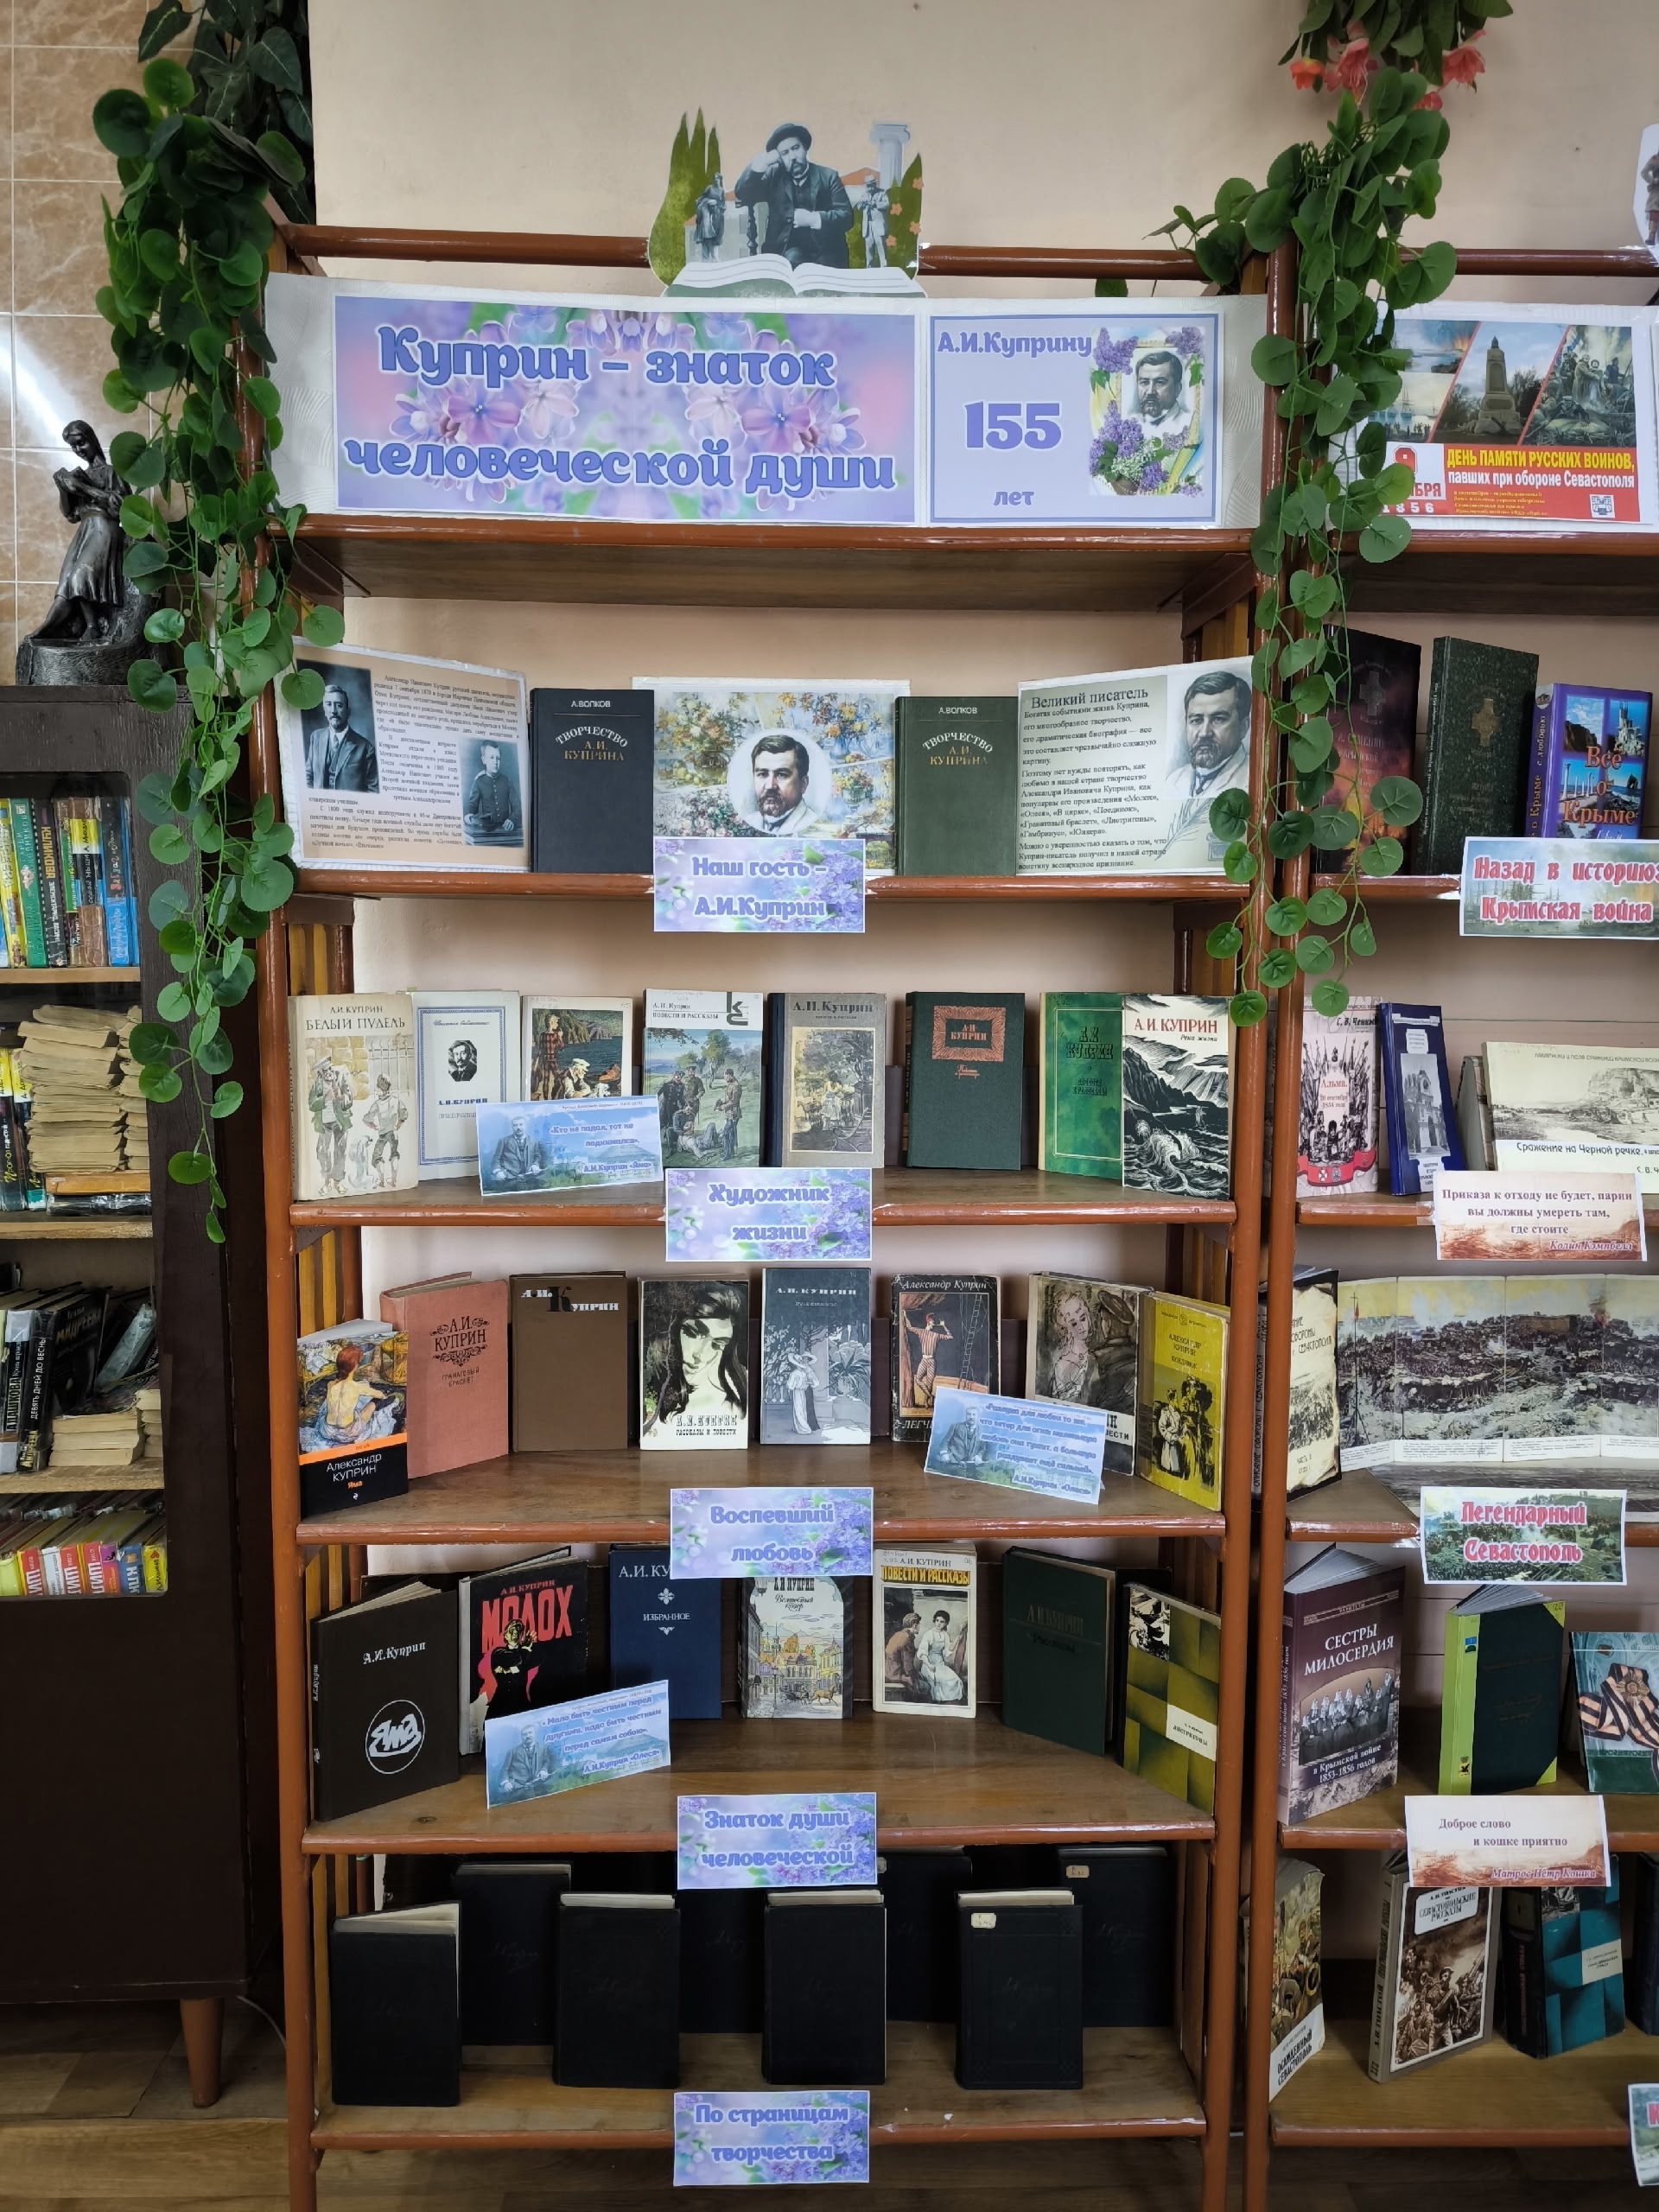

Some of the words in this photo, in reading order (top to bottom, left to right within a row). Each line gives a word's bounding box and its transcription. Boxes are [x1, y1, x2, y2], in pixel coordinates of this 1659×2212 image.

[938, 332, 1092, 358] А.И.Куприну
[378, 326, 589, 389] Куприн
[646, 349, 834, 386] знаток
[964, 400, 1062, 450] 155
[345, 438, 732, 488] человеческой
[747, 453, 895, 495] души
[1447, 449, 1477, 468] ДЕНЬ
[1480, 450, 1526, 467] ПАМЯТИ
[1529, 451, 1581, 469] РУССКИХ
[1584, 452, 1635, 472] ВОИНОВ,
[1448, 471, 1491, 486] павших
[1493, 473, 1512, 488] при
[1515, 470, 1561, 489] обороне
[1564, 471, 1635, 488] Севастополя
[993, 490, 1034, 506] лет
[1032, 692, 1086, 709] Великий
[1090, 689, 1148, 702] писатель
[555, 726, 628, 747] ТВОРЧЕСТВО
[922, 732, 993, 753] ТВОРЧЕСТВО
[564, 750, 624, 761] КУПРИНА
[1585, 746, 1624, 770] Всё
[1562, 800, 1636, 828] Крыме
[41, 826, 55, 879] КУЛИКОВА
[692, 856, 745, 877] Наш
[750, 858, 810, 879] гость
[1474, 857, 1535, 882] Назад
[1548, 861, 1559, 880] в
[695, 897, 825, 920] А.И.Куприн
[1482, 897, 1580, 923] Крымская
[1593, 900, 1653, 923] война
[357, 1017, 405, 1029] ПУДЕЛЬ
[1161, 1017, 1218, 1034] КУПРИН
[950, 1032, 987, 1041] КУПРИН
[1516, 1142, 1562, 1153] Сражение
[1579, 1145, 1612, 1155] Черной
[709, 1184, 830, 1206] Художник
[1442, 1189, 1491, 1203] Приказа
[1494, 1192, 1502, 1200] к
[1505, 1191, 1542, 1203] отходу
[1560, 1189, 1595, 1204] будет,
[1598, 1192, 1632, 1204] парни
[1468, 1209, 1484, 1217] вы
[1487, 1208, 1534, 1219] должны
[1536, 1209, 1583, 1220] умереть
[1586, 1209, 1610, 1219] там,
[733, 1225, 807, 1242] жизни
[1510, 1225, 1529, 1236] где
[1532, 1225, 1568, 1235] стоите
[903, 1278, 951, 1291] Александр
[954, 1279, 987, 1290] Куприн
[435, 1328, 486, 1352] КУПРИН
[35, 1363, 43, 1373] ДО
[32, 1375, 41, 1394] ДНЕЙ
[30, 1395, 39, 1420] ДЕВЯТЬ
[327, 1453, 382, 1473] Александр
[333, 1465, 377, 1482] КУПРИН
[347, 1481, 363, 1490] Яма
[710, 1503, 835, 1524] Воспевший
[1460, 1501, 1587, 1528] Легендарный
[731, 1542, 815, 1561] любовь
[1464, 1538, 1582, 1563] Севастополь
[881, 1565, 918, 1581] ПОВЕСТИ
[920, 1567, 926, 1581] И
[928, 1568, 971, 1586] РАССКАЗЫ
[481, 1585, 574, 1655] МОЛОХ
[643, 1612, 690, 1622] ИЗБРАННОЕ
[1325, 1624, 1377, 1650] СЕСТРЫ
[1304, 1635, 1395, 1675] МИЛОСЕРДИЯ
[547, 1715, 569, 1726] Мало
[571, 1710, 591, 1719] быть
[593, 1702, 627, 1715] честным
[628, 1696, 652, 1707] перед
[607, 1717, 626, 1727] быть
[627, 1709, 662, 1722] честным
[564, 1743, 589, 1753] перед
[1319, 1751, 1358, 1773] Крымской
[1360, 1744, 1382, 1758] войне
[1319, 1763, 1355, 1783] 1853-1856
[1357, 1758, 1376, 1771] годов
[705, 1811, 783, 1830] Знаток
[788, 1810, 849, 1832] души
[1439, 1818, 1477, 1830] Доброе
[1480, 1820, 1511, 1830] слово
[1473, 1838, 1480, 1847] и
[1484, 1838, 1518, 1847] кошке
[1522, 1838, 1567, 1849] приятно
[702, 1846, 855, 1868] человеческой
[1491, 1868, 1530, 1880] Матрос
[1562, 1868, 1596, 1880] Кошка
[695, 2105, 724, 2123] По
[728, 2107, 849, 2126] страницам
[712, 2145, 834, 2165] творчества
